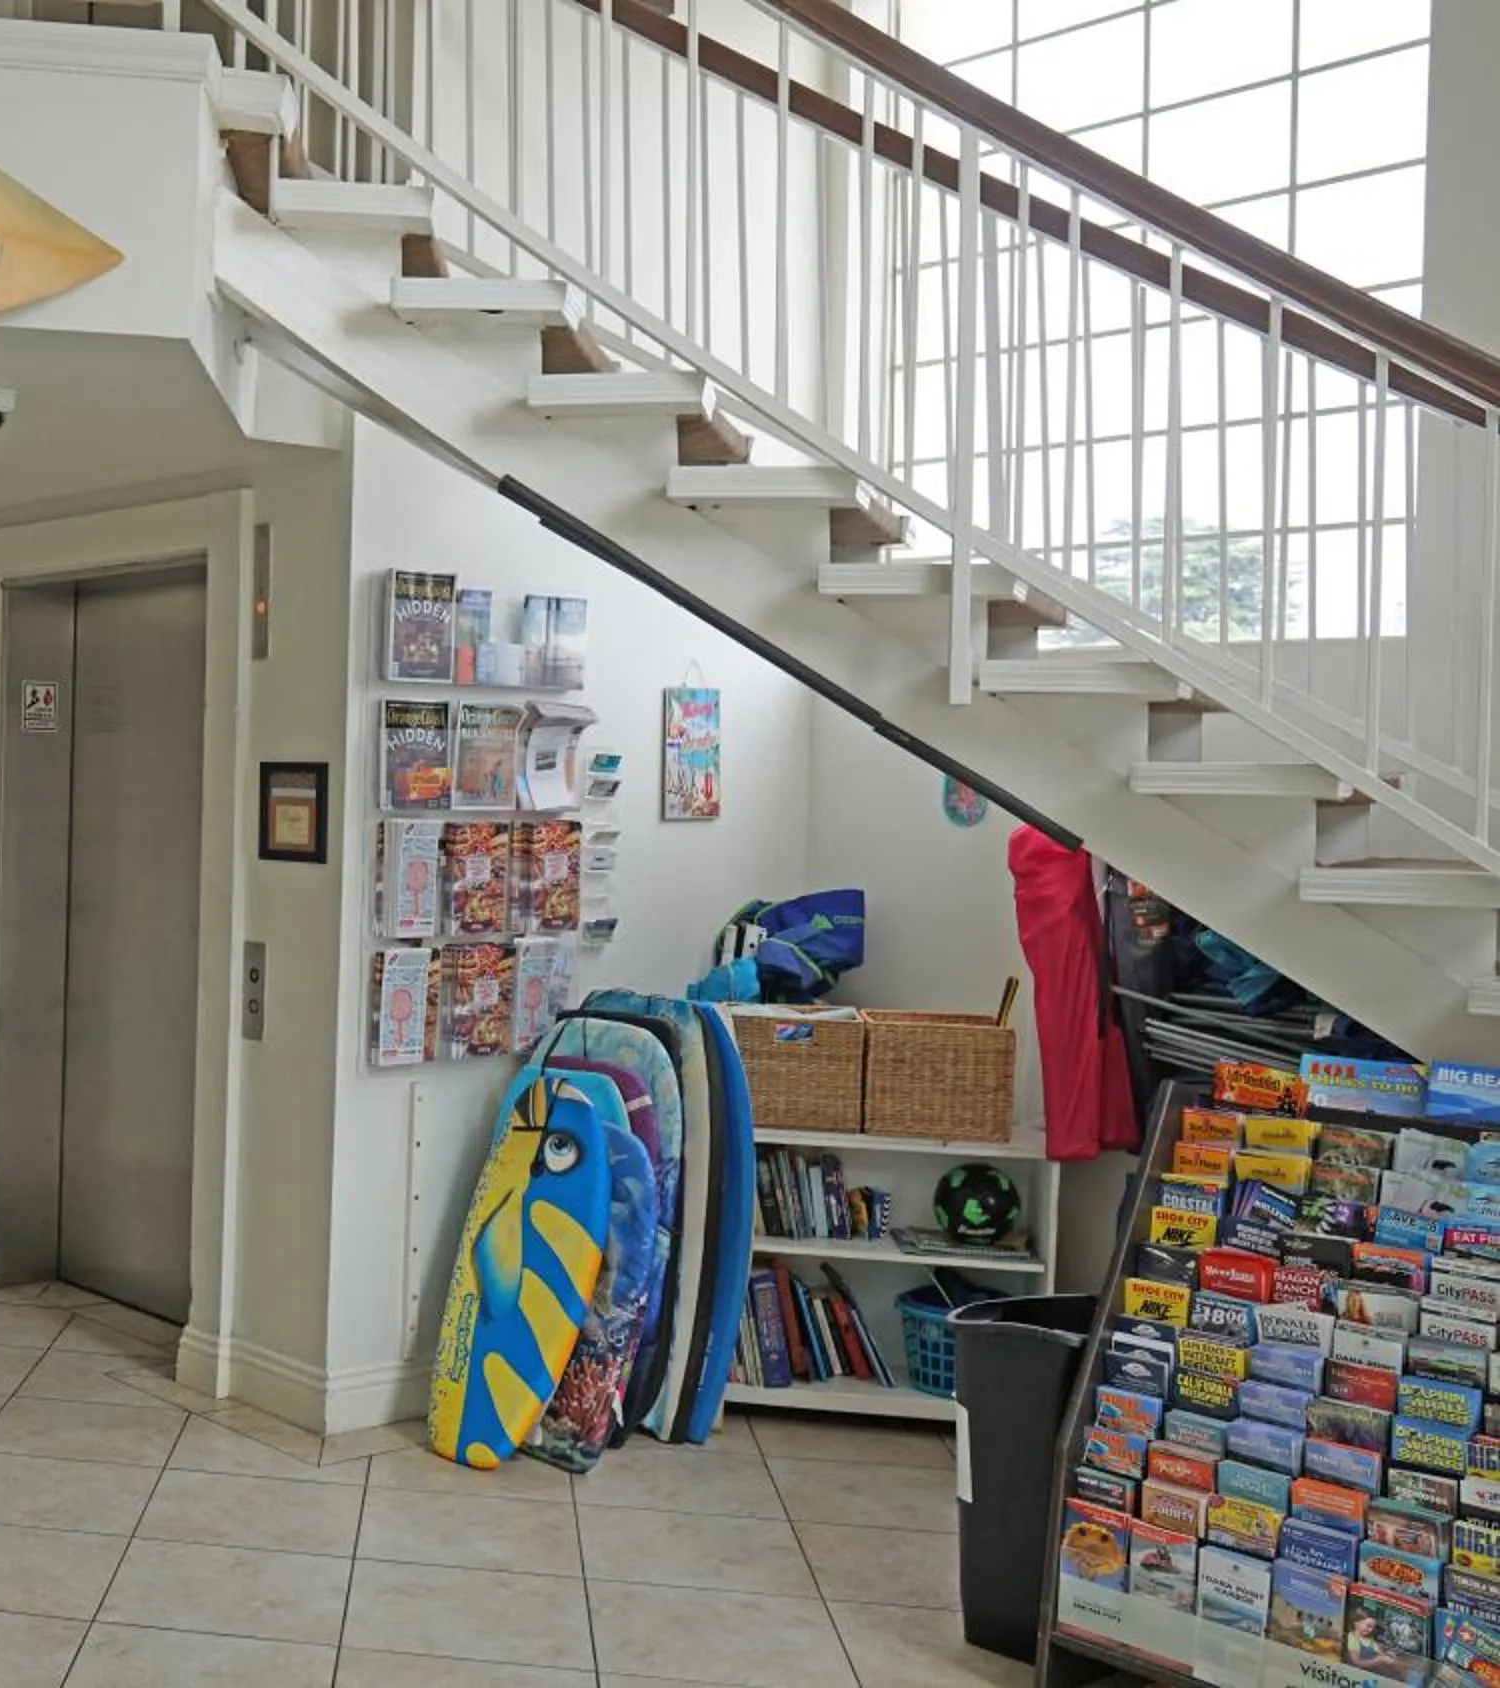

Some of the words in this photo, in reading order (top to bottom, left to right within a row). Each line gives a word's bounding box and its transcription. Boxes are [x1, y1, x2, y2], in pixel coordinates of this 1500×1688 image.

[394, 599, 451, 624] HIDDEN
[387, 728, 445, 752] HIDDEN
[1438, 1066, 1468, 1085] BIG
[1162, 1192, 1215, 1213] COASTAL
[1187, 1214, 1209, 1227] CITY
[1453, 1231, 1476, 1244] EAT
[1163, 1288, 1185, 1301] CITY
[1275, 1281, 1317, 1296] RANCH
[1437, 1283, 1497, 1304] CityPASS
[1139, 1299, 1172, 1315] NIKE
[1427, 1323, 1489, 1347] CityPASS
[1299, 1659, 1362, 1688] visitor
